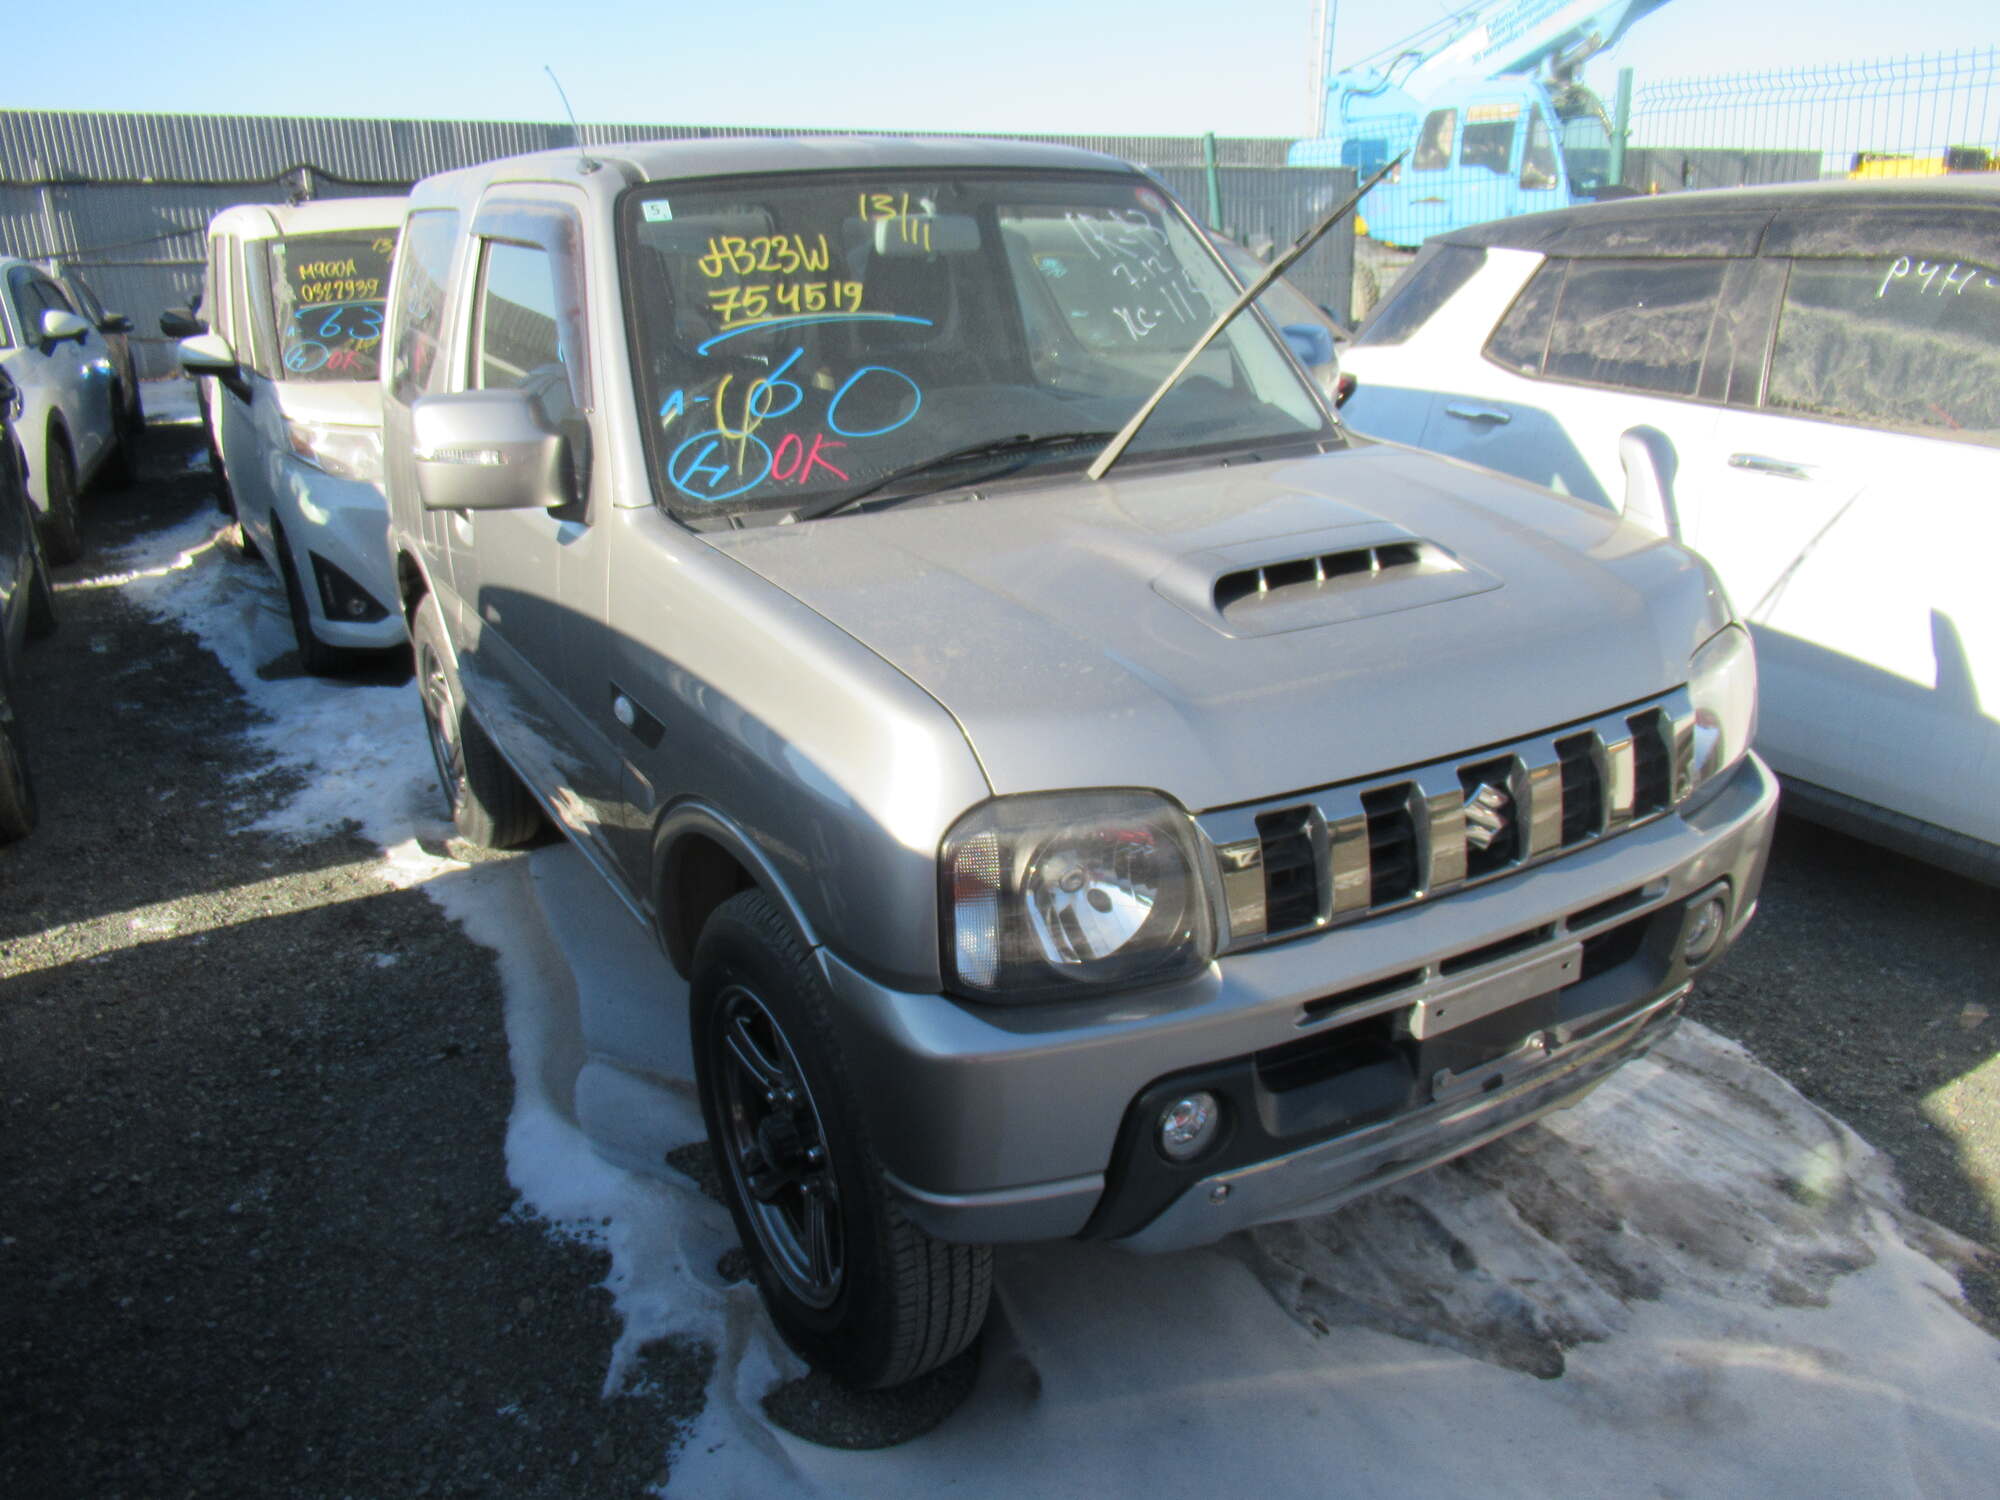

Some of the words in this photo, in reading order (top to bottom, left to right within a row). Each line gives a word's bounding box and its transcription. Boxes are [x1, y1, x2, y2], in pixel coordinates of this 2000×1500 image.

[699, 234, 830, 277] JB23W
[708, 281, 862, 321] 754519
[771, 433, 849, 484] OK
